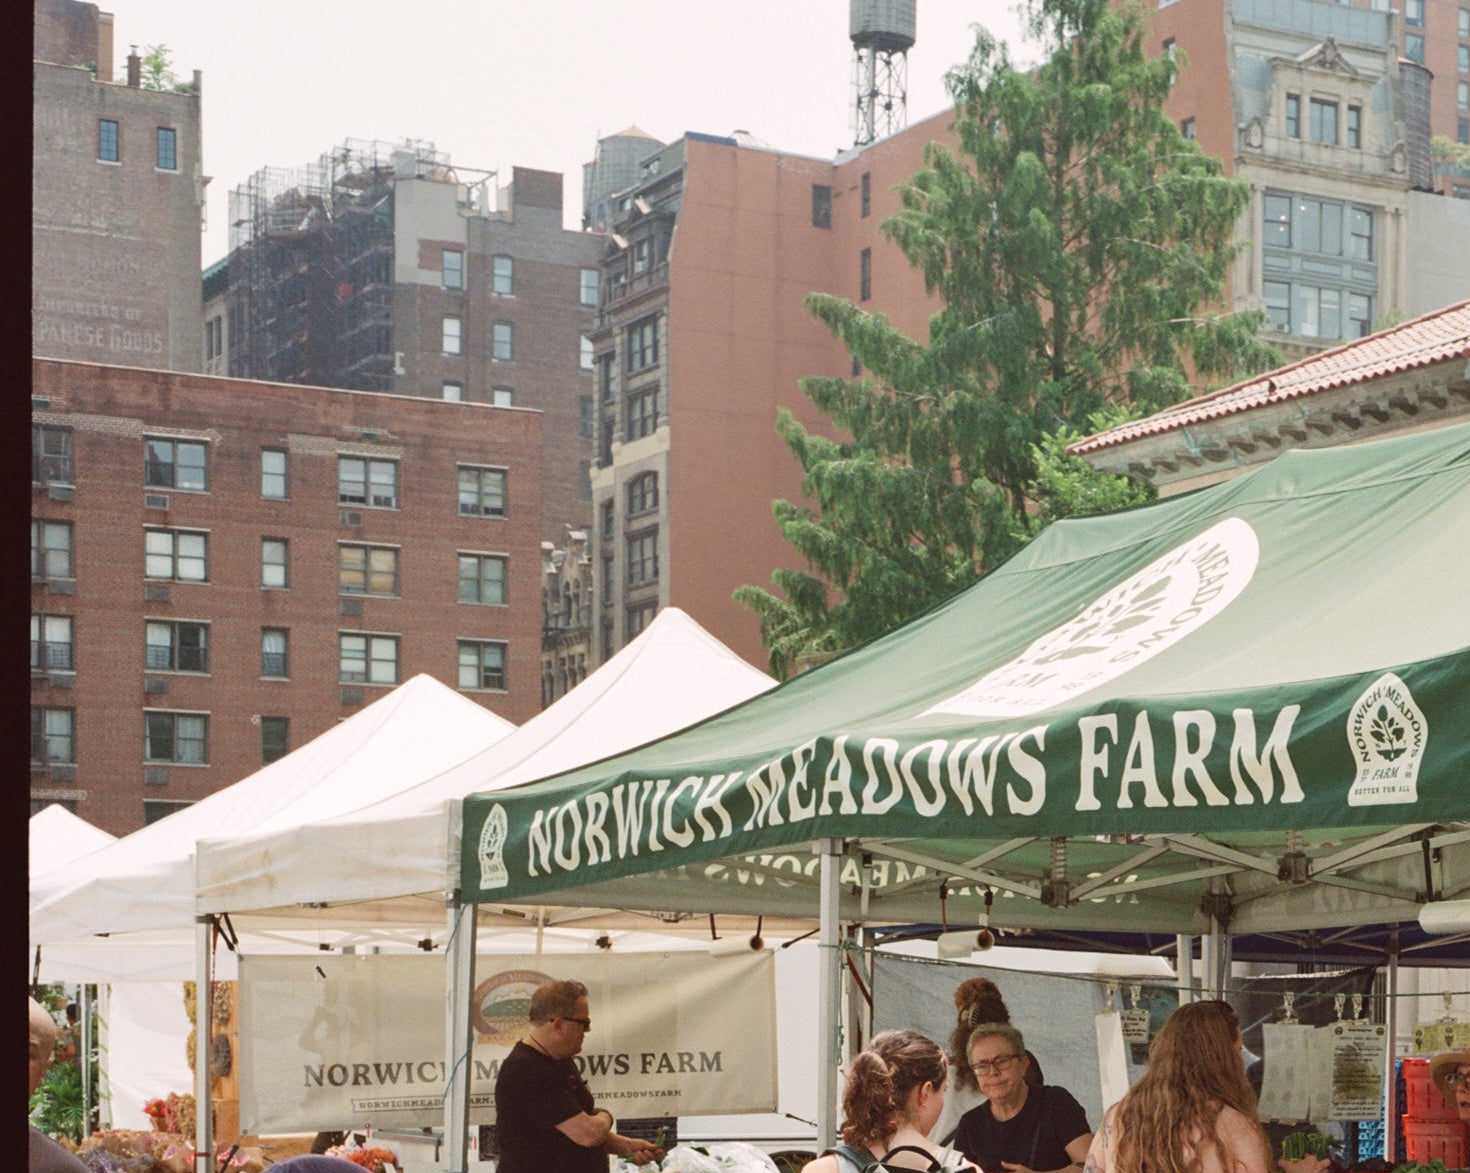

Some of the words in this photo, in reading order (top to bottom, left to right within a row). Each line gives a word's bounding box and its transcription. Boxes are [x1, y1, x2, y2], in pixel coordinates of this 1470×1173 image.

[1353, 688, 1382, 763] NORWICH
[1384, 685, 1422, 758] MEADOWS
[527, 770, 744, 877] NORWICH
[743, 725, 1050, 832] MEADOWS
[1074, 703, 1305, 812] FARM
[1371, 766, 1400, 781] FARM
[640, 1050, 723, 1075] FARM
